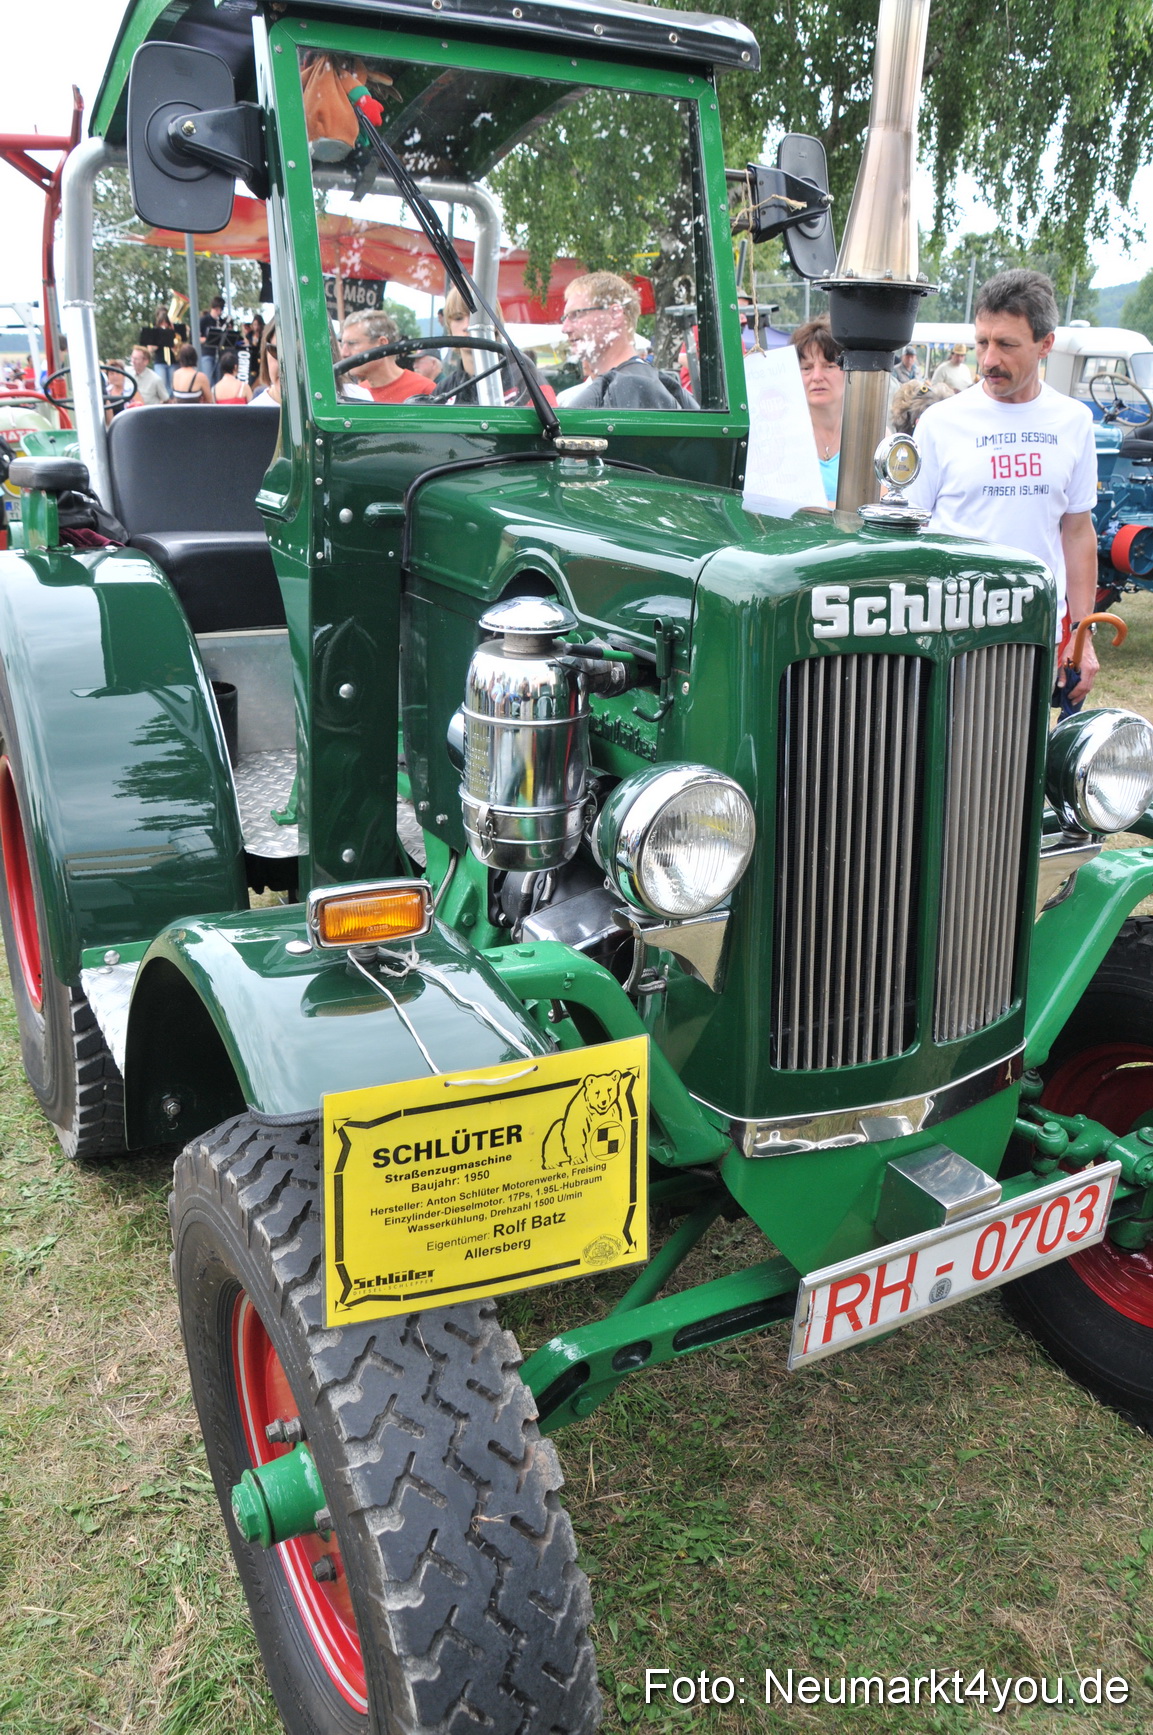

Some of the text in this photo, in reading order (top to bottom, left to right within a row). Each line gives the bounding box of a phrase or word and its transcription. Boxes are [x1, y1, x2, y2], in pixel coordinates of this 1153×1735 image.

[976, 432, 1058, 448] LIMITED SESSION
[991, 453, 1041, 479] 1956
[982, 484, 1049, 496] FRASER ISLAND
[811, 578, 1034, 638] Schlüter
[372, 1124, 523, 1169] SCHLÜTER
[384, 1153, 513, 1184] Straßenzugmaschine
[411, 1169, 490, 1193] Baujahr: 1950
[370, 1162, 607, 1217] Hersteller: Anton Schlüter Motorenwerke, Freising
[384, 1174, 603, 1226] Einzylinder-Dieselmotor. 17Ps, 1.95L-Hubraum
[407, 1191, 583, 1234] Wasserkühlung, Drehzahl 1500 U/min
[426, 1211, 566, 1252] Eigentümer: Rolf Batz
[464, 1239, 531, 1261] Allersberg
[353, 1269, 435, 1290] Schlüter
